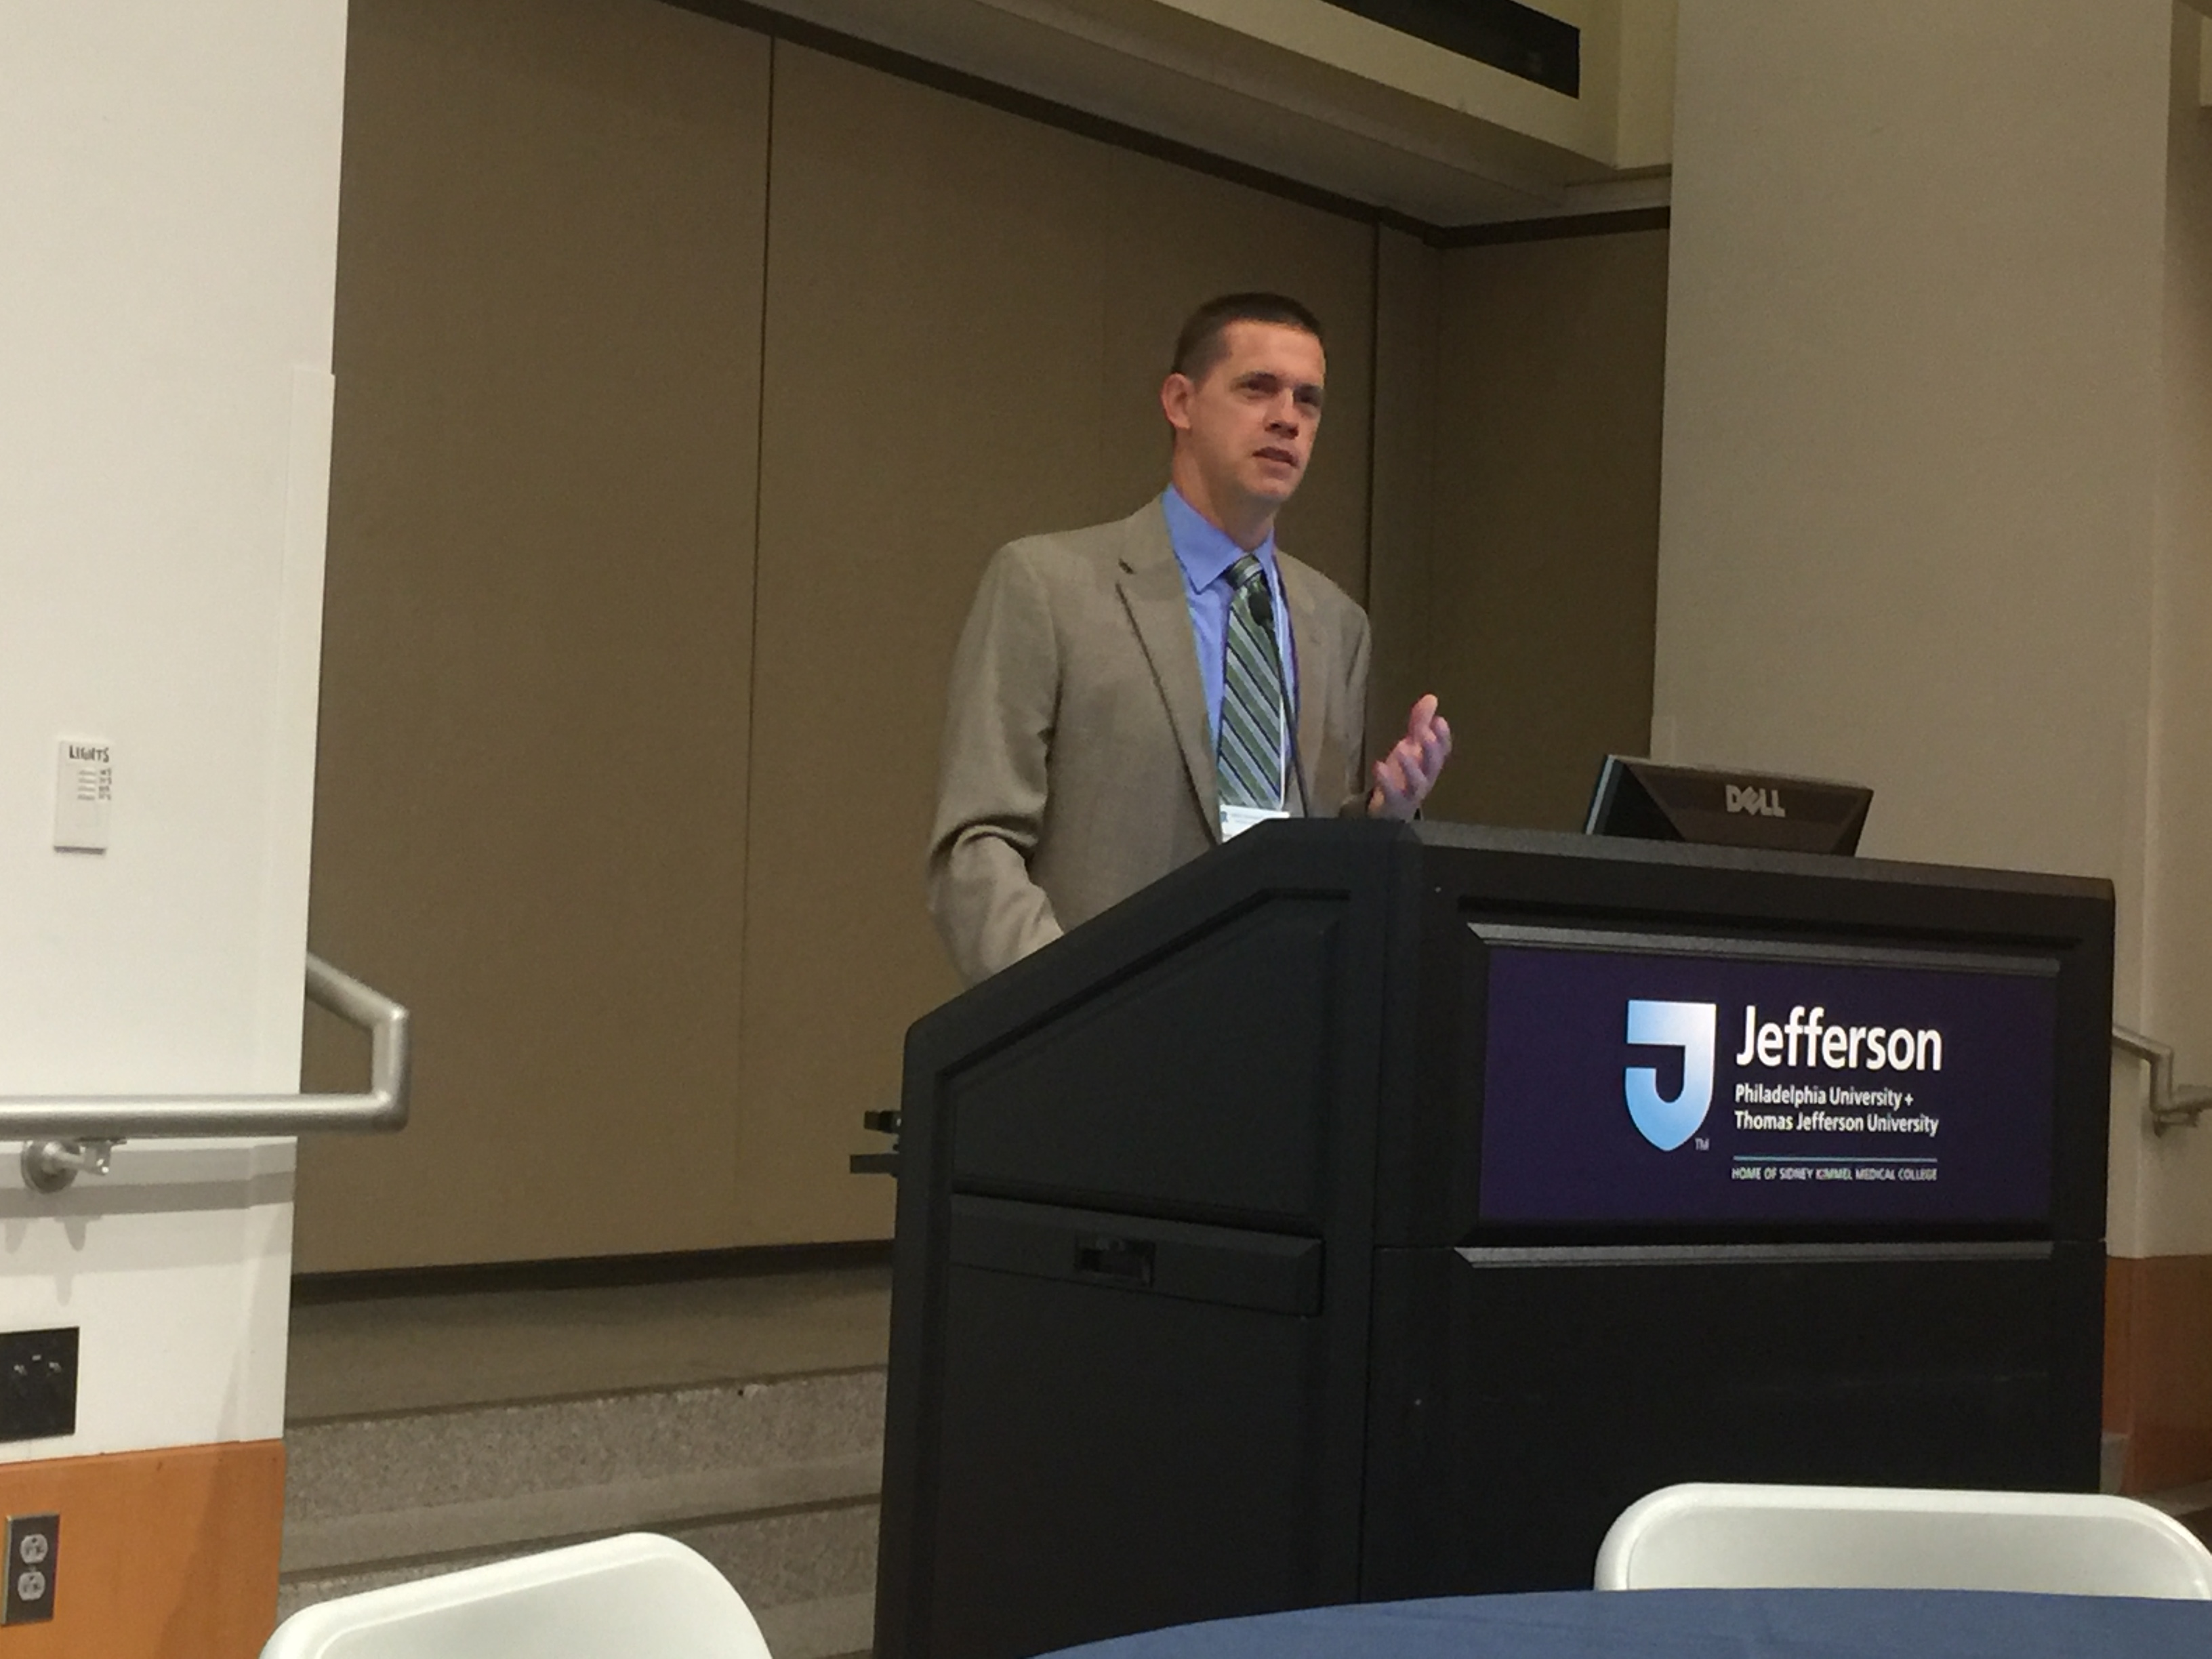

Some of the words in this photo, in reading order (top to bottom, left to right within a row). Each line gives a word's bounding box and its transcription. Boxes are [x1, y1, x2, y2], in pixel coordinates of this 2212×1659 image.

[1725, 784, 1786, 818] DELL
[1736, 1004, 1942, 1071] Jefferson
[1735, 1083, 1826, 1107] Philadelphia
[1830, 1085, 1903, 1110] University
[1735, 1110, 1793, 1130] Thomas
[1796, 1111, 1864, 1132] Jefferson
[1867, 1114, 1939, 1137] University
[1732, 1168, 1761, 1180] HOME
[1764, 1168, 1777, 1180] OF
[1856, 1168, 1896, 1181] MEDICAL
[1898, 1169, 1938, 1181] COLLEGE
